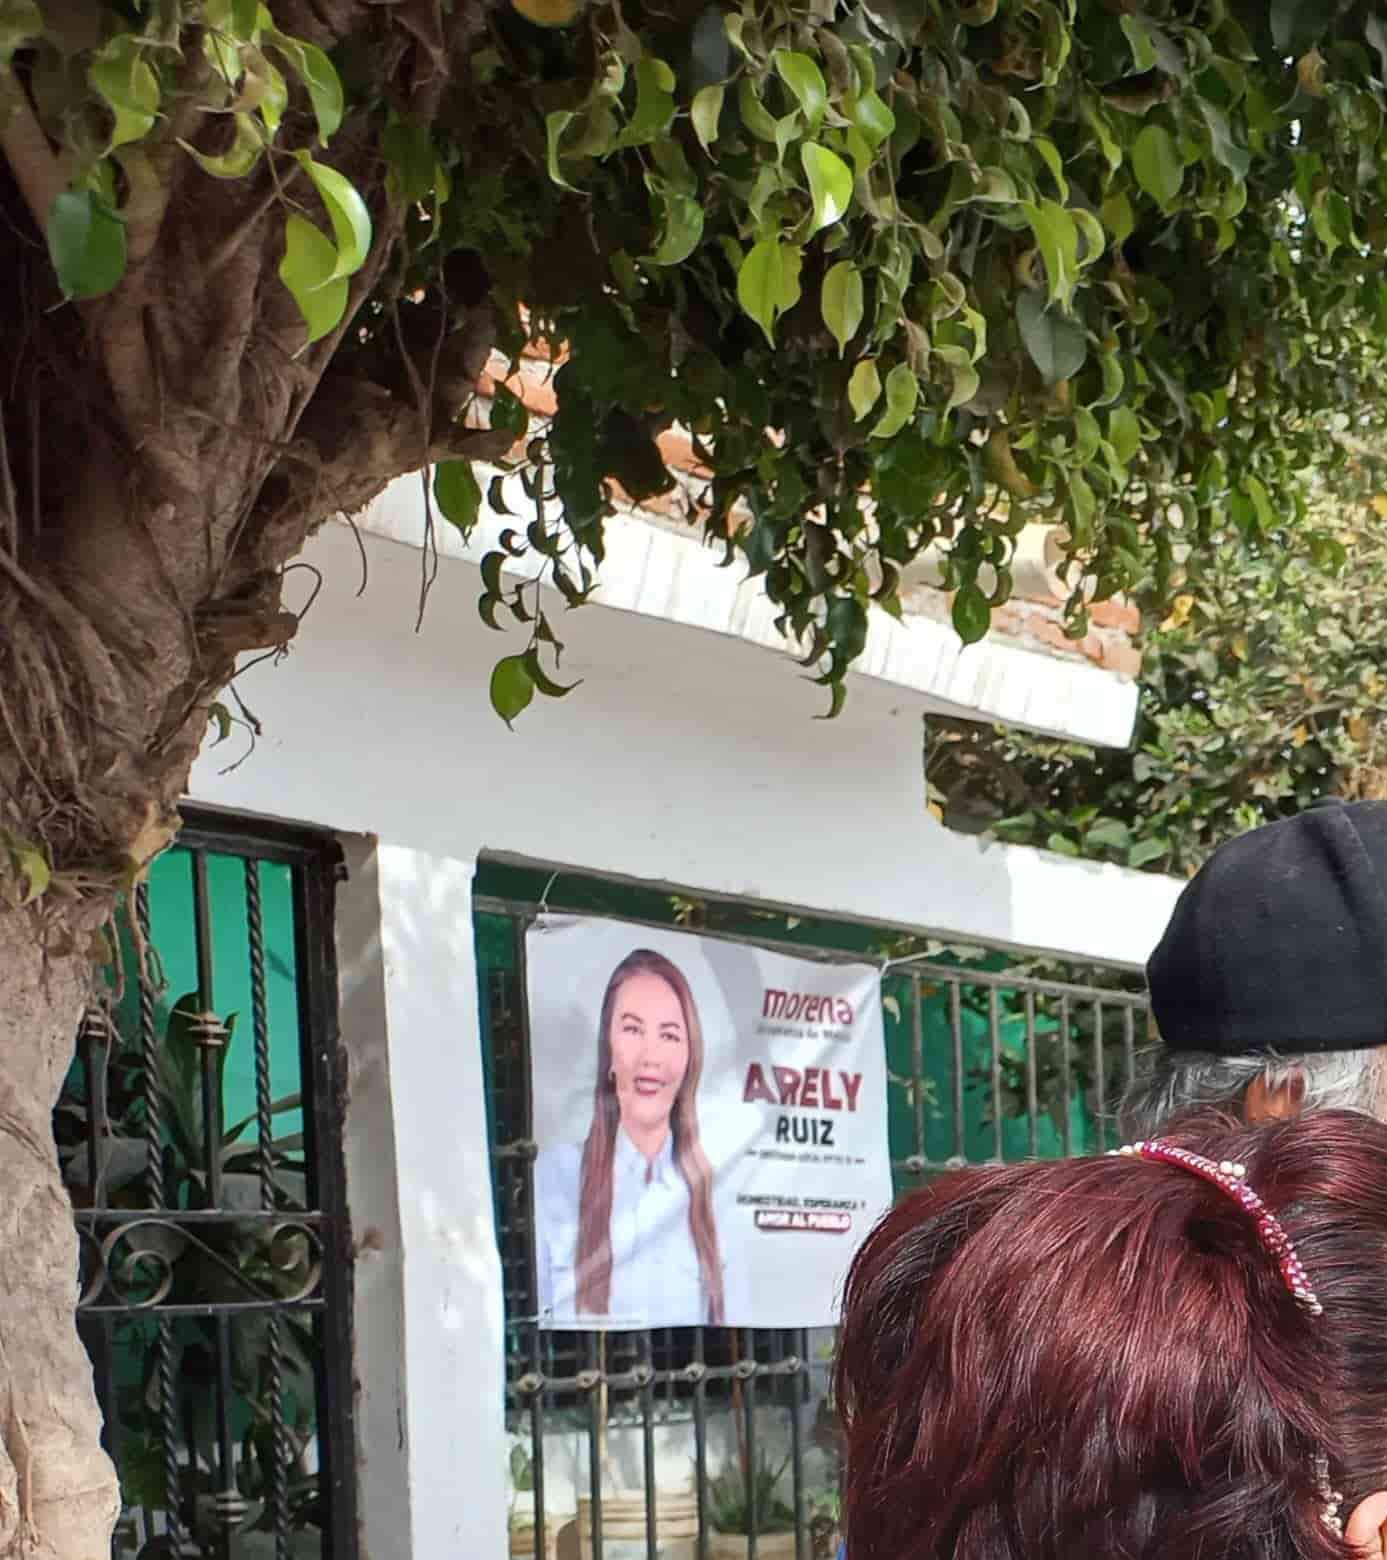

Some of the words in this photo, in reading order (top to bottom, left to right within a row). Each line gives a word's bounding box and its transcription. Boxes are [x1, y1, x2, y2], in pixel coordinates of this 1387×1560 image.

[762, 988, 854, 1025] morena
[743, 1061, 863, 1112] ARELY
[776, 1115, 835, 1146] RUIZ
